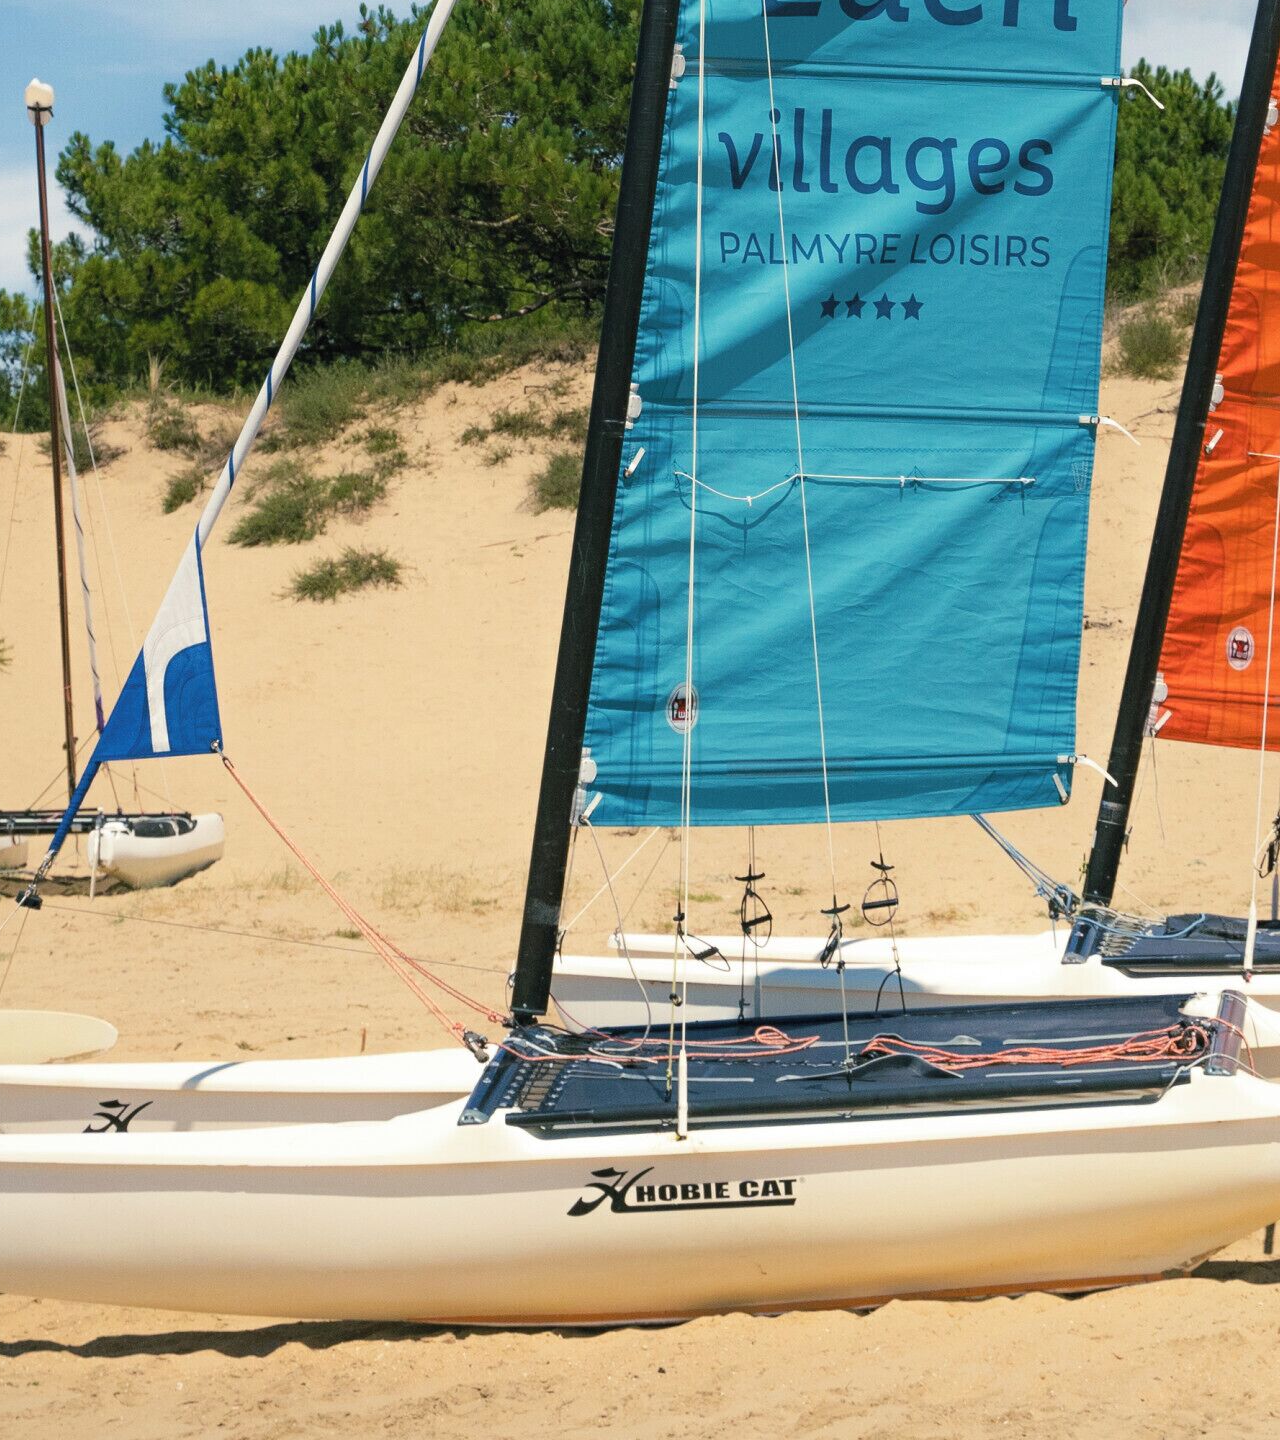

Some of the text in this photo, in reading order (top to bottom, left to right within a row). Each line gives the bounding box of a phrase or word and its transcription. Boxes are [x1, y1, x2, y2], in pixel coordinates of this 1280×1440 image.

[718, 106, 1055, 215] villages
[719, 230, 1050, 268] PALMYRE LOISIRS
[635, 1178, 797, 1203] HOBIE CAT
